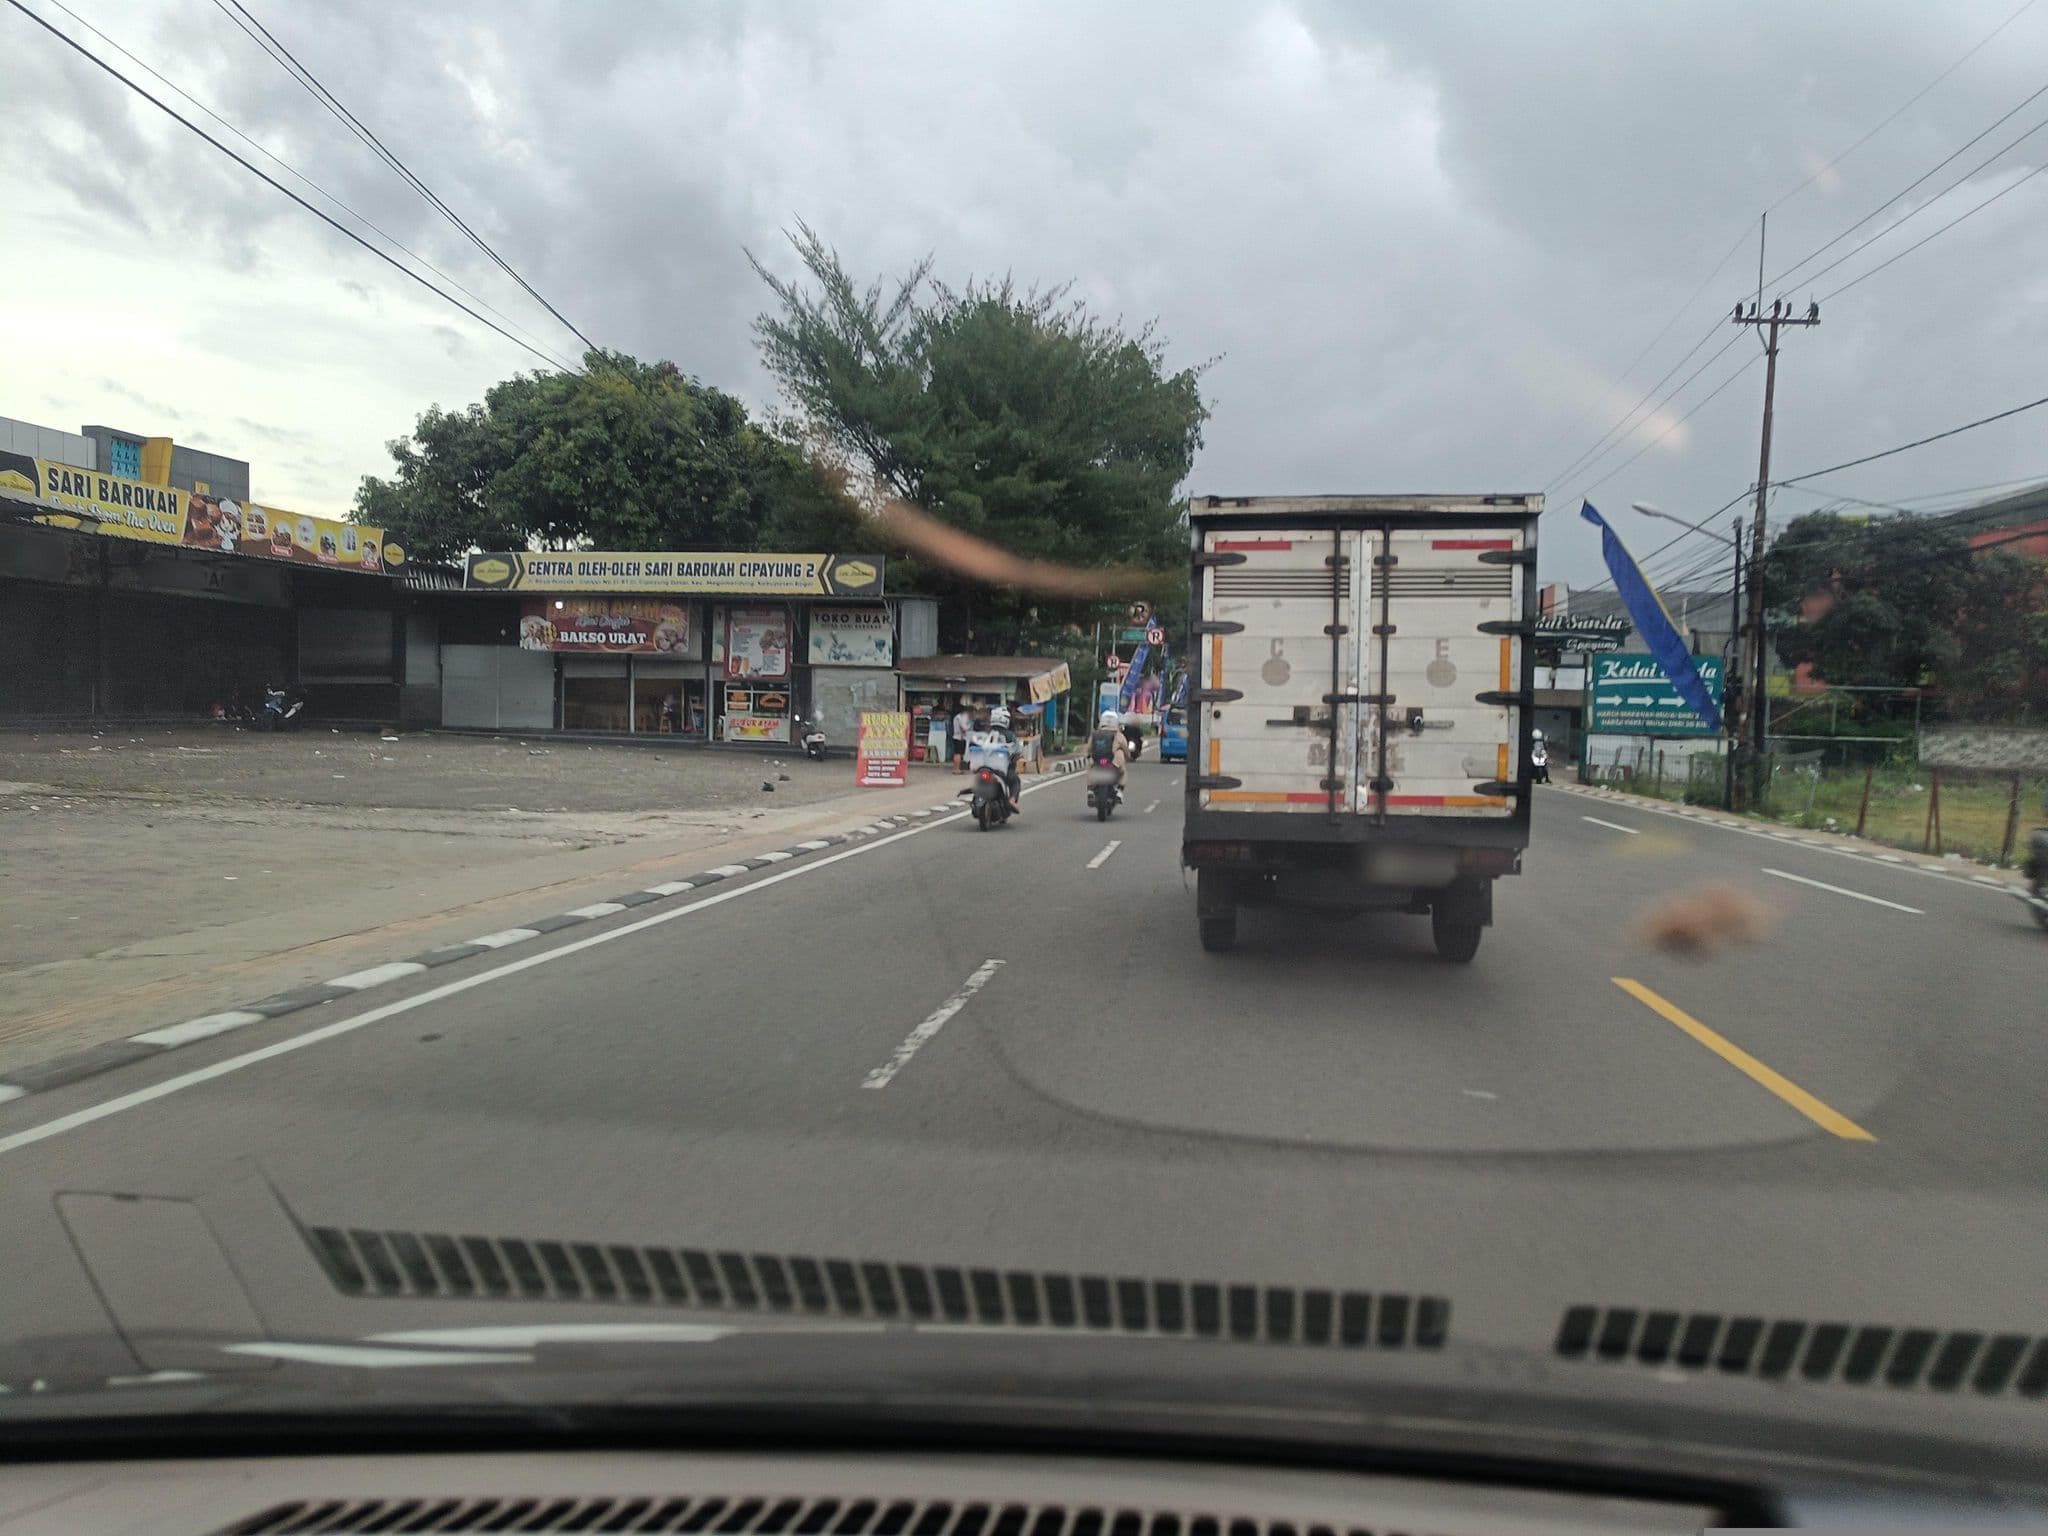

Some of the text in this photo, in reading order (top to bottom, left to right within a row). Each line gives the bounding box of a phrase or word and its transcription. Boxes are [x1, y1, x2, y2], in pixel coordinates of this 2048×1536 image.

[48, 467, 92, 499] SARI
[98, 478, 178, 515] BAROKAH
[146, 513, 177, 535] Oven
[528, 561, 815, 578] CENTRA OLEH-OLEH SARI BAROKAH CIPAYUNG 2
[814, 613, 891, 625] TOKO BUAH
[560, 631, 647, 644] BAKSO URAT
[1599, 660, 1657, 678] Kedai
